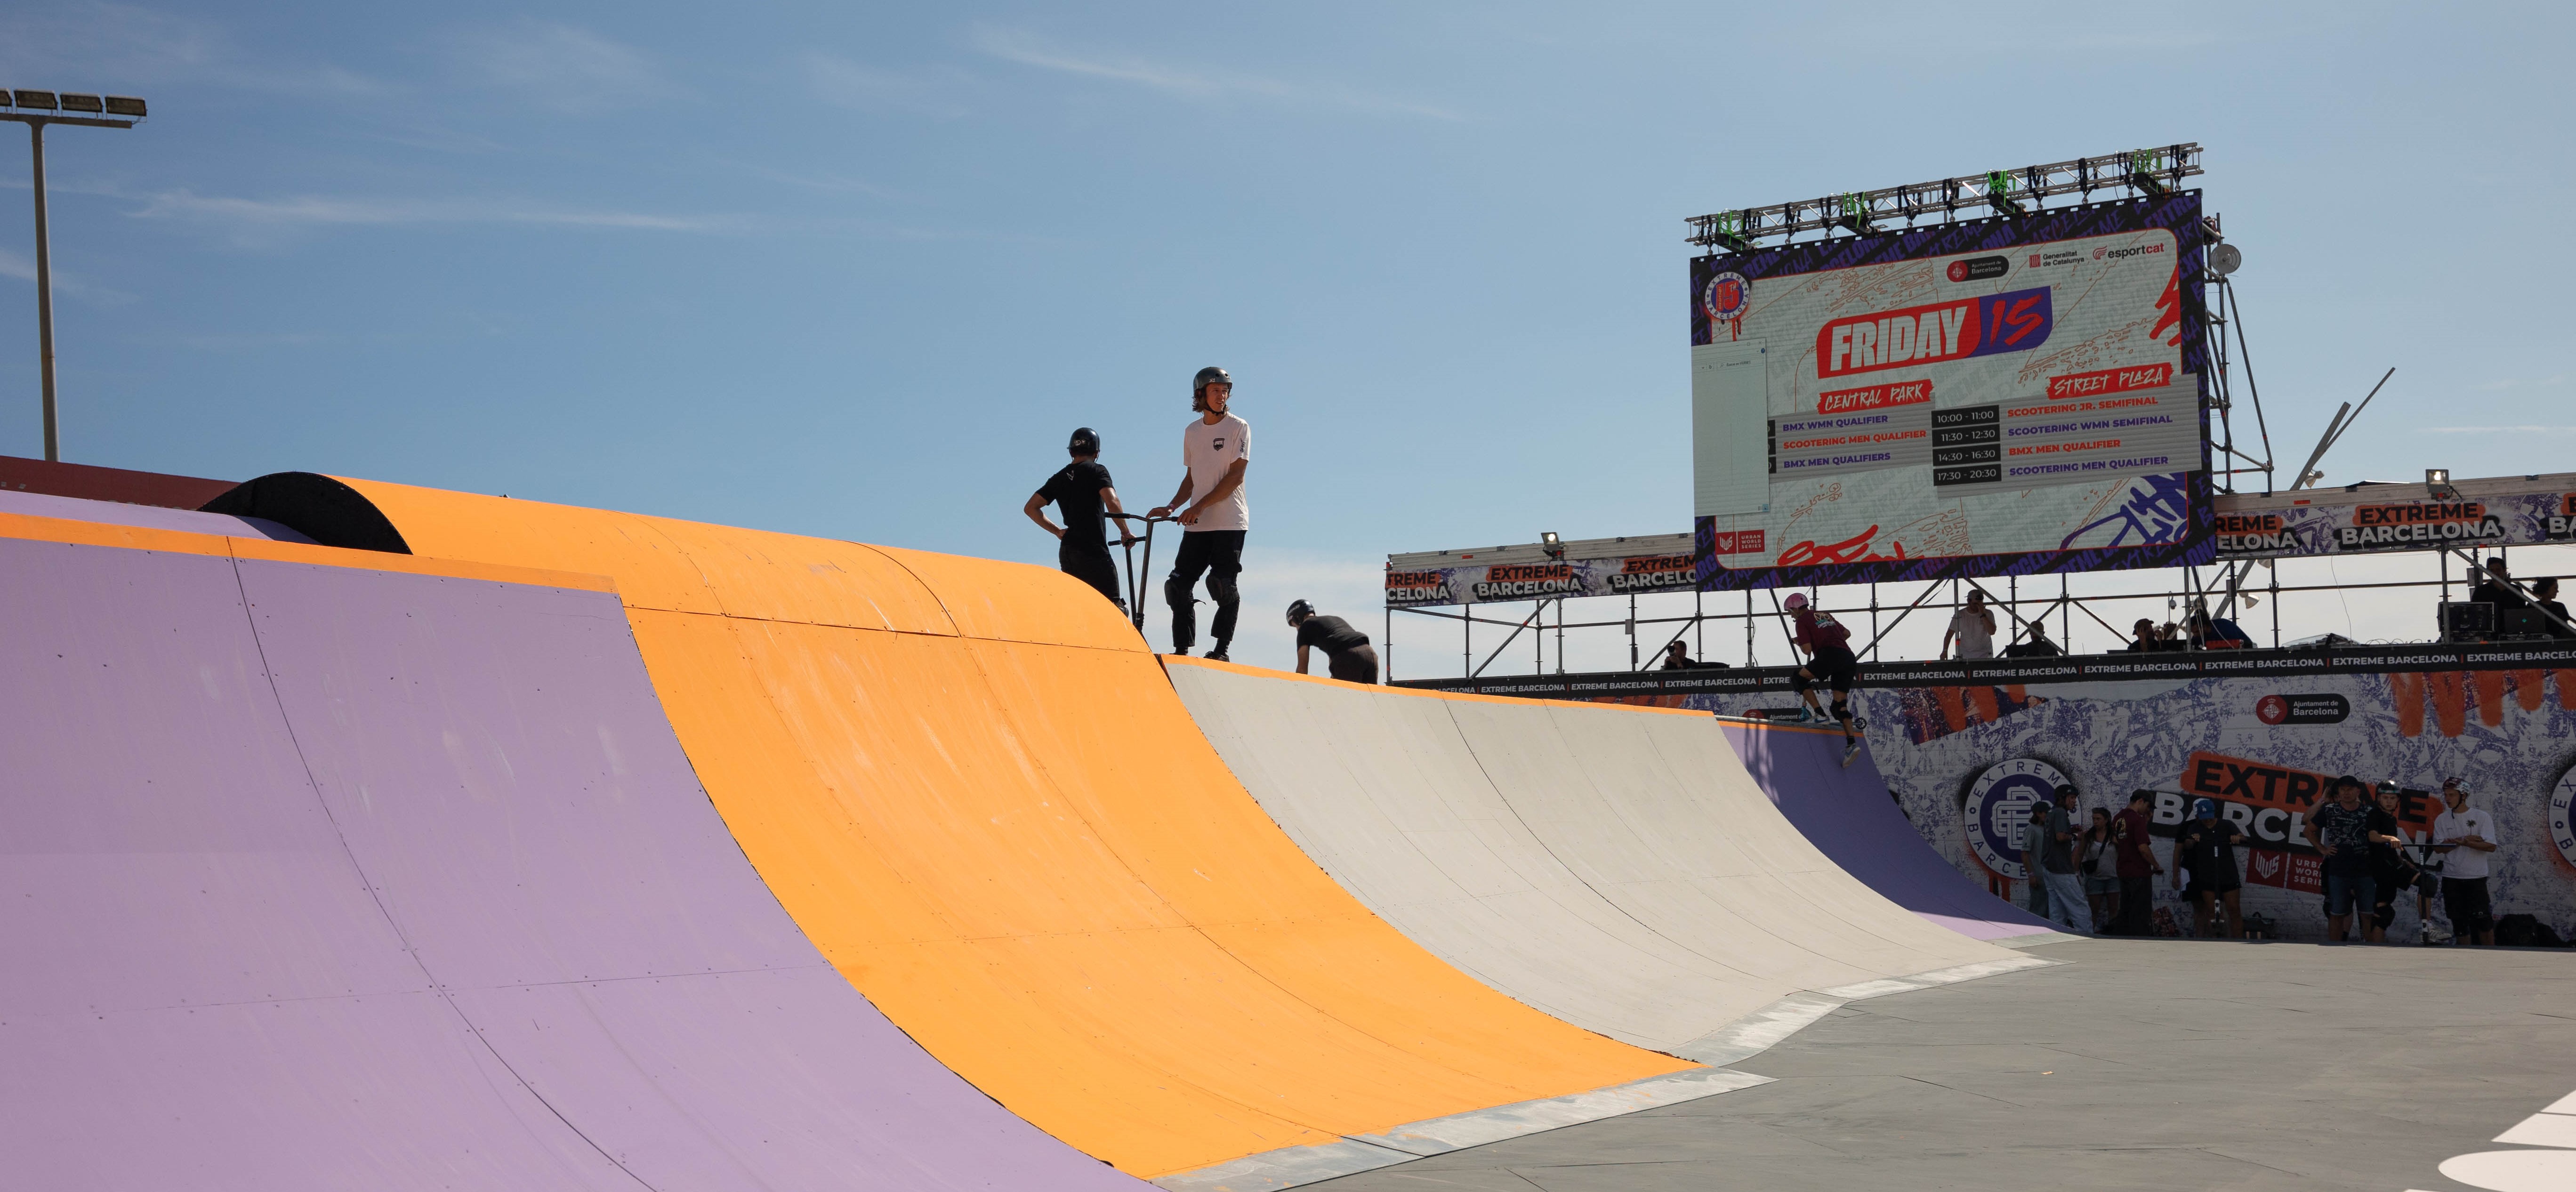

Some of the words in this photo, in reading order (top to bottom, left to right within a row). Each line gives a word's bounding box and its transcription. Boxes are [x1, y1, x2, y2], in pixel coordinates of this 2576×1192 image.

[2043, 250, 2077, 259] Generalitat
[2108, 243, 2165, 260] esportcat
[2053, 257, 2085, 266] Catalunya
[1972, 265, 2002, 274] Barcelona
[1708, 273, 1746, 291] EXTREME
[1706, 293, 1749, 319] BARCELONA
[1829, 303, 1970, 372] FRIDAY
[1989, 294, 2044, 346] 15
[2054, 375, 2109, 395] STREET
[2119, 367, 2163, 387] PLAZA
[1825, 389, 1882, 411] CENTRAL
[1890, 384, 1923, 403] PARK
[2007, 404, 2077, 417] SCOOTERING
[2079, 402, 2096, 411] JR.
[2099, 397, 2158, 410] SEMIFINAL
[1783, 423, 1804, 431] BMX
[1807, 420, 1834, 429] WMN
[1836, 415, 1888, 427] QUALIFIER
[1937, 414, 1962, 423] 10:00
[1972, 411, 1994, 419] 11:00
[2008, 423, 2077, 436] SCOOTERING
[2080, 420, 2109, 430] WMN
[2112, 415, 2173, 427] SEMIFINAL
[1783, 437, 1846, 449] SCOOTERING
[1848, 435, 1871, 444] MEN
[1873, 430, 1926, 443] QUALIFIER
[1941, 433, 1963, 442] 11:30
[1972, 430, 1995, 439] 12:30
[2009, 446, 2033, 456] BMX
[2036, 444, 2060, 453] MEN
[2062, 439, 2121, 452] QUALIFIER
[1783, 460, 1805, 468] BMX
[1808, 458, 1830, 467] MEN
[1832, 453, 1891, 465] QUALIFIERS
[1938, 452, 1963, 462] 14:30
[1972, 450, 1996, 459] 16:30
[2009, 463, 2079, 476] SCOOTERING
[2082, 461, 2106, 470] MEN
[2109, 456, 2168, 469] QUALIFIER
[1937, 472, 1961, 480] 17:30
[1970, 469, 1996, 478] 20:30
[2359, 502, 2479, 524] EXTREME
[2342, 519, 2501, 545] BARCELONA
[1491, 565, 1569, 580] EXTREME
[1478, 578, 1583, 596] BARCELONA
[2333, 656, 2384, 666] EXTREME
[2387, 654, 2457, 664] BARCELONA
[2467, 652, 2522, 662] EXTREME
[2084, 664, 2131, 674] EXTREME
[2133, 662, 2197, 672] BARCELONA
[2205, 660, 2254, 670] EXTREME
[2257, 658, 2324, 668] BARCELONA
[1864, 672, 1907, 681] EXTREME
[1909, 671, 1965, 679] BARCELONA
[1972, 669, 2016, 677] EXTREME
[2018, 667, 2077, 677] BARCELONA
[1481, 684, 1516, 693] EXTREME
[1519, 684, 1565, 692] BARCELONA
[1571, 683, 1607, 691] EXTREME
[1610, 681, 1658, 689] BARCELONA
[1665, 679, 1703, 688] EXTREME
[1705, 677, 1756, 686] BARCELONA
[2293, 707, 2338, 716] Barcelona
